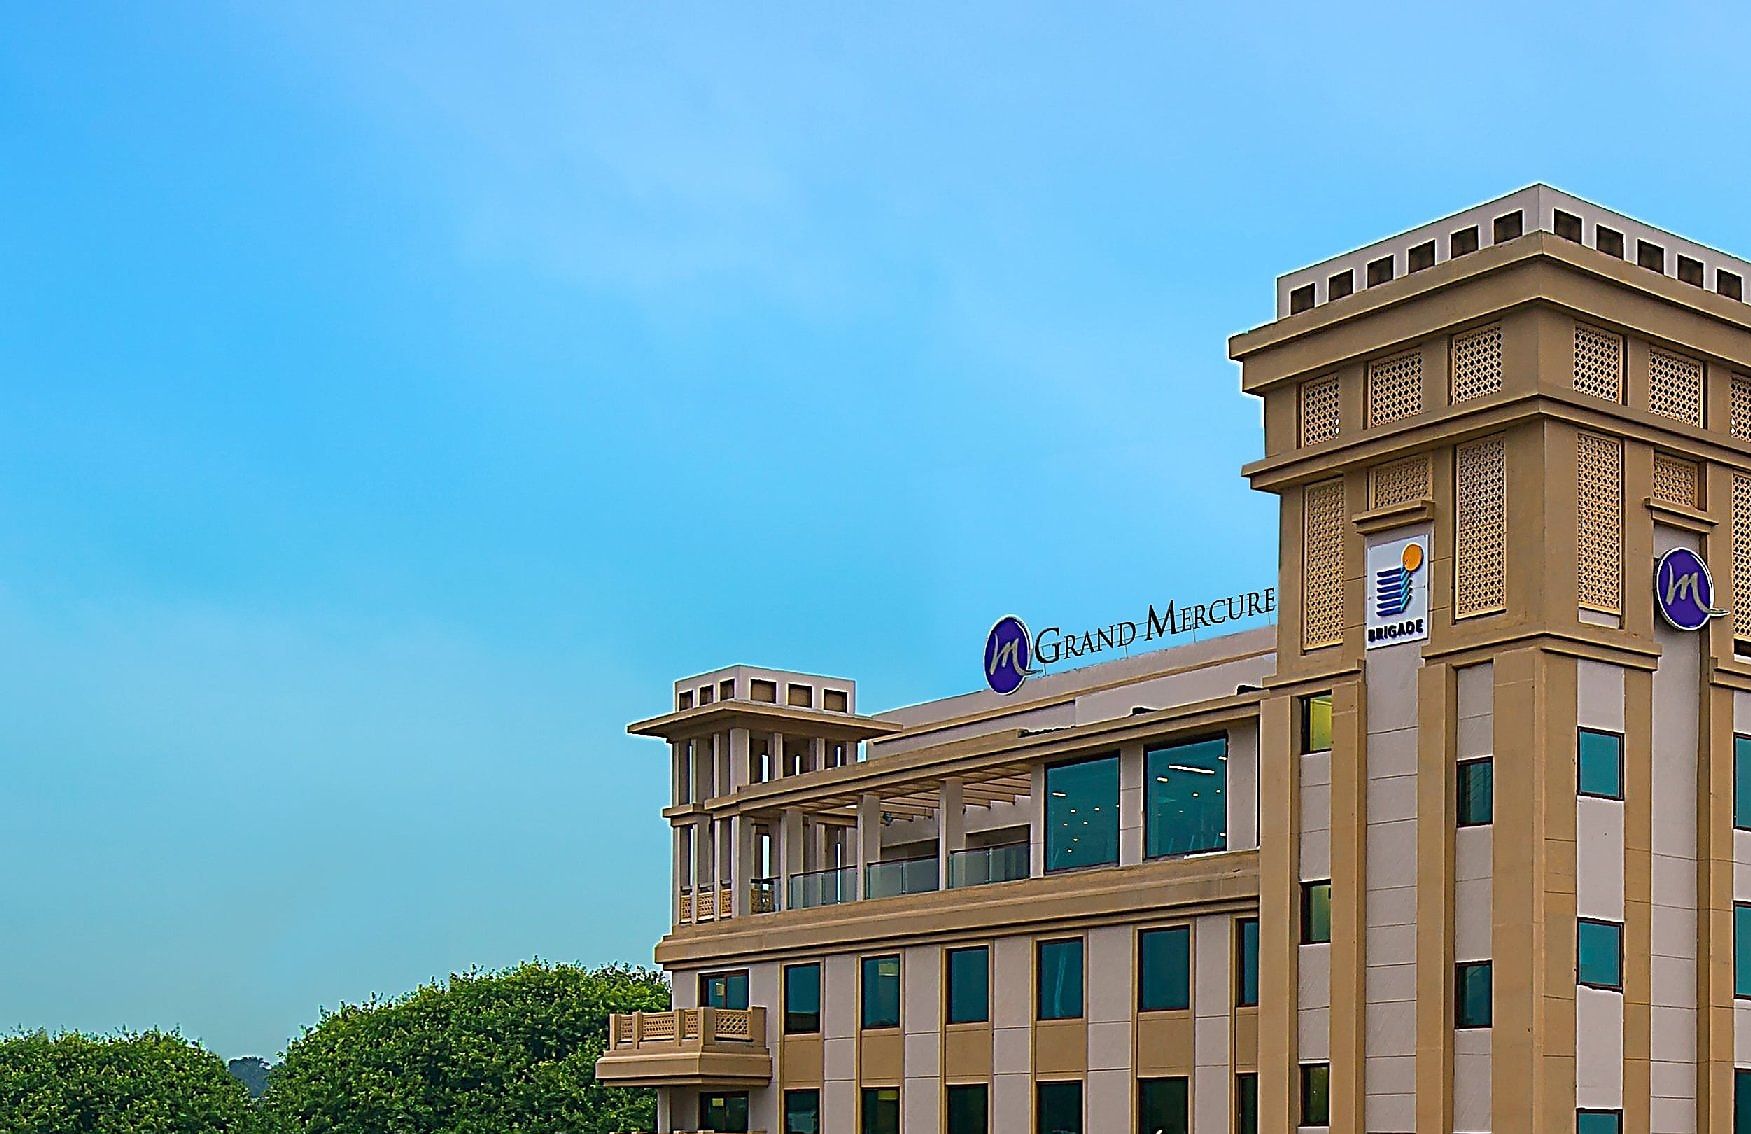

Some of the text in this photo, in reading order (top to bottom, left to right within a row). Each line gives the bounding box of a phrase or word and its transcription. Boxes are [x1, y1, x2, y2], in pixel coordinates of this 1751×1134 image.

[1034, 621, 1137, 664] GRAND
[1144, 587, 1274, 641] MERCURE
[1367, 619, 1424, 642] BRIGADE
